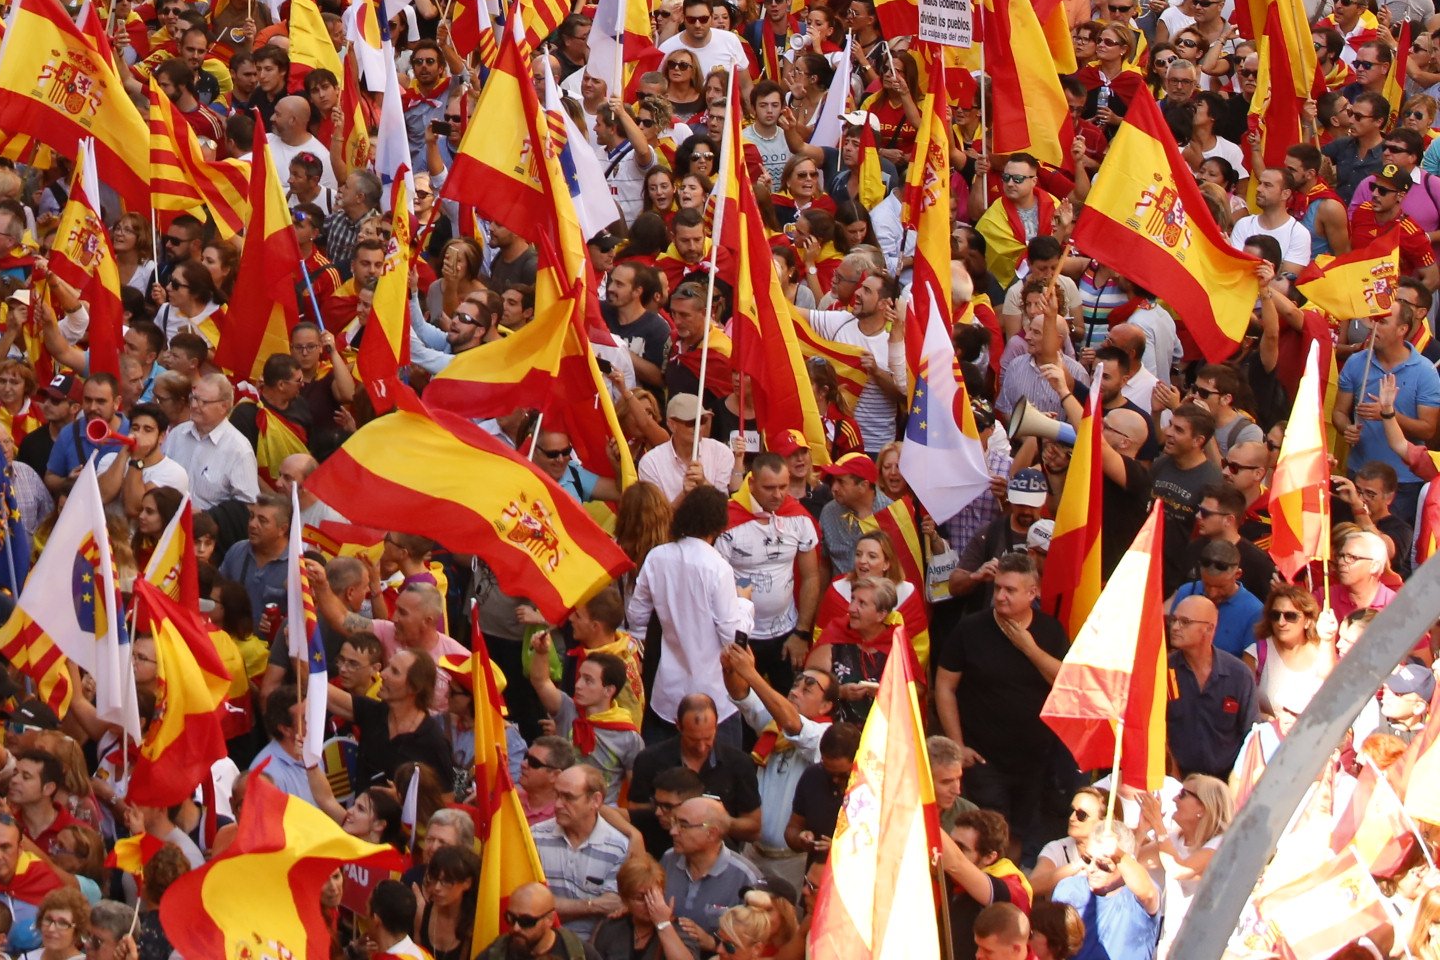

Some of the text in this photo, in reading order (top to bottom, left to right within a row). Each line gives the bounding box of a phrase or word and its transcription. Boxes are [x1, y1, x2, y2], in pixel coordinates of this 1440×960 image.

[920, 11, 938, 26] dividen
[947, 17, 971, 32] pueblos.
[927, 561, 956, 575] Algesal
